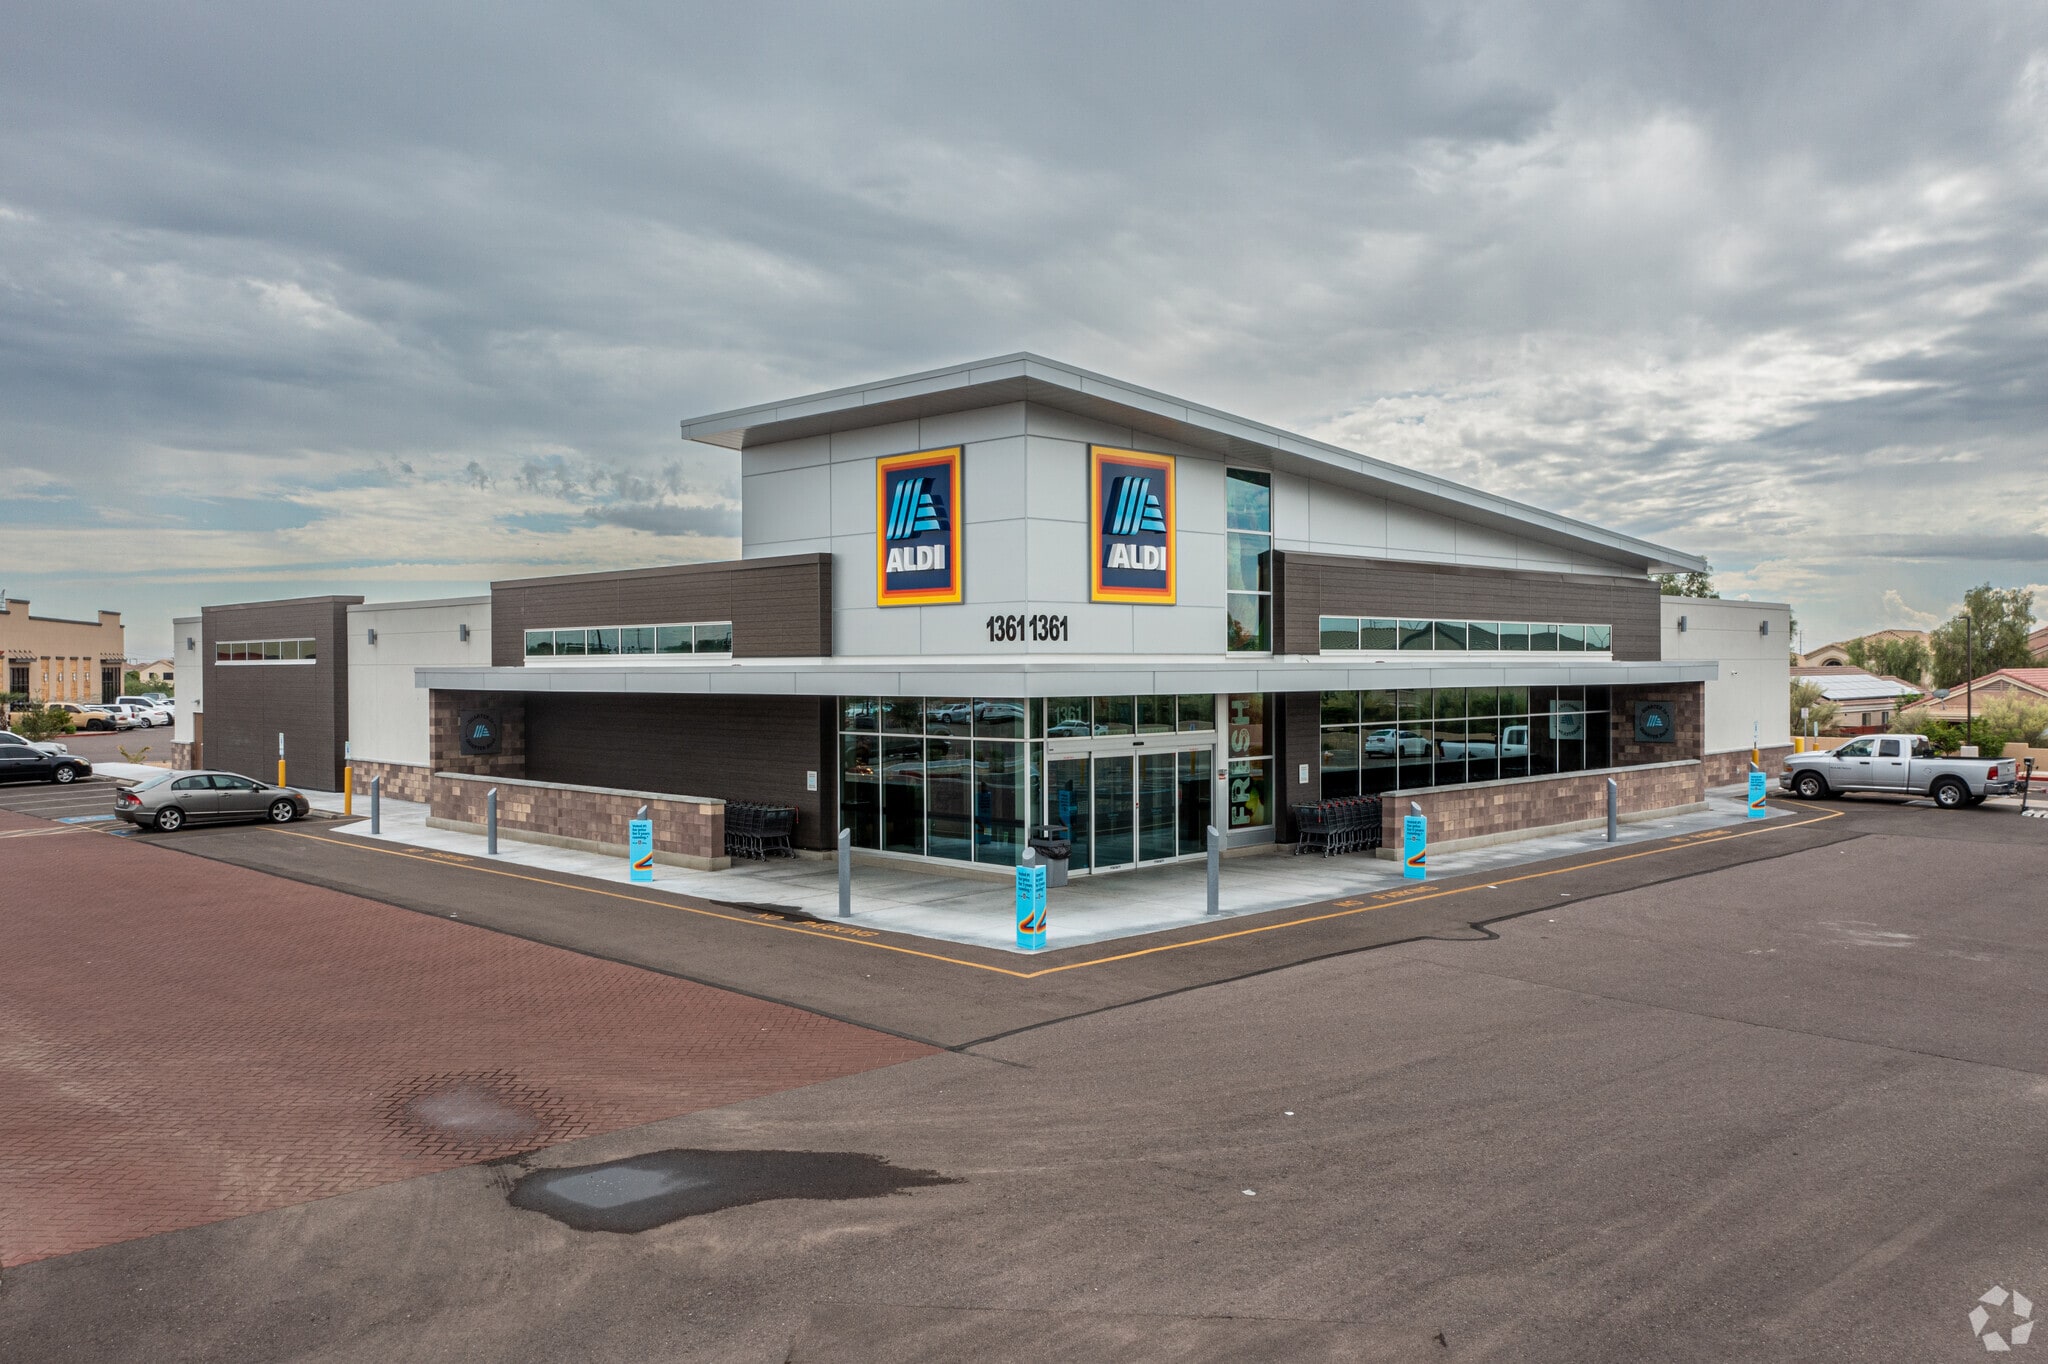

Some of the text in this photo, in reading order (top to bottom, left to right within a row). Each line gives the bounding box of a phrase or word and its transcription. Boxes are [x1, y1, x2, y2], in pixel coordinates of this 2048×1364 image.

[886, 543, 946, 573] ALDI
[1107, 542, 1167, 571] ALDI
[986, 614, 1025, 642] 1361
[1028, 614, 1069, 642] 1361
[1231, 700, 1251, 825] FRESH
